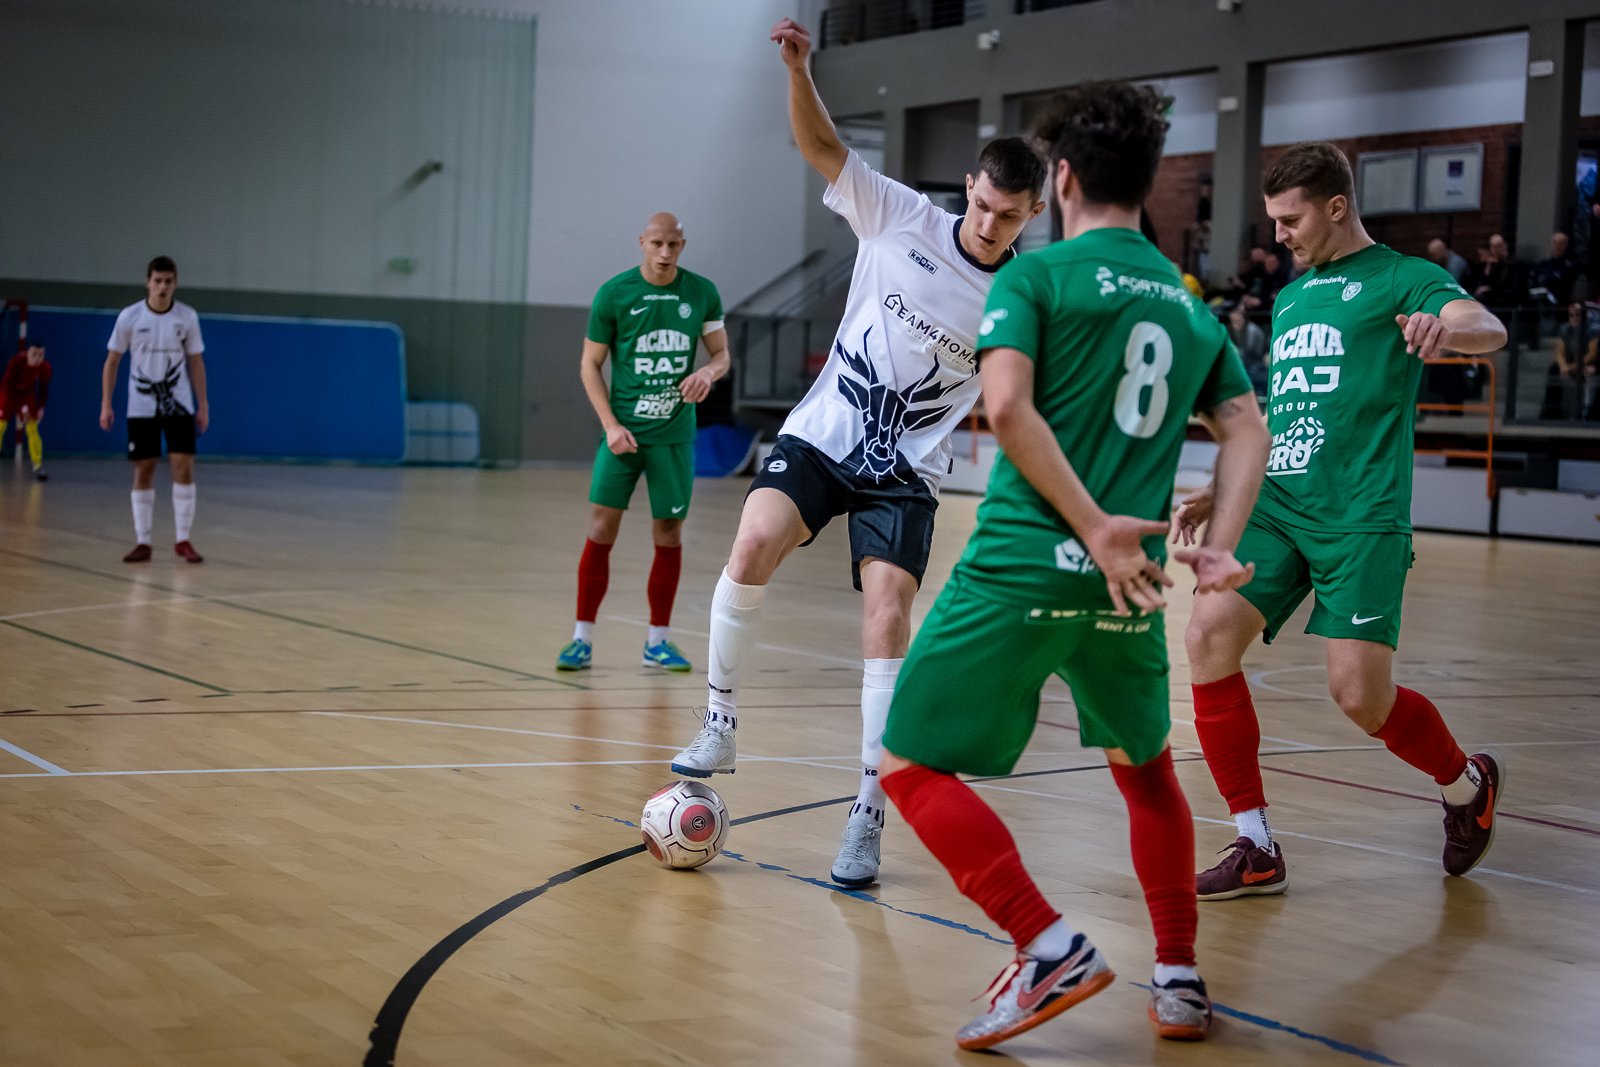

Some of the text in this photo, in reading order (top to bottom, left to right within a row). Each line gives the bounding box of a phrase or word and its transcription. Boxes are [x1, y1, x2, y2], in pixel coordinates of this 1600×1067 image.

[635, 329, 691, 353] ACANA
[634, 356, 688, 375] RAJ
[1114, 321, 1173, 439] 8
[1270, 366, 1341, 402] RAJ
[634, 400, 674, 416] PRO
[1273, 402, 1318, 415] GROUP
